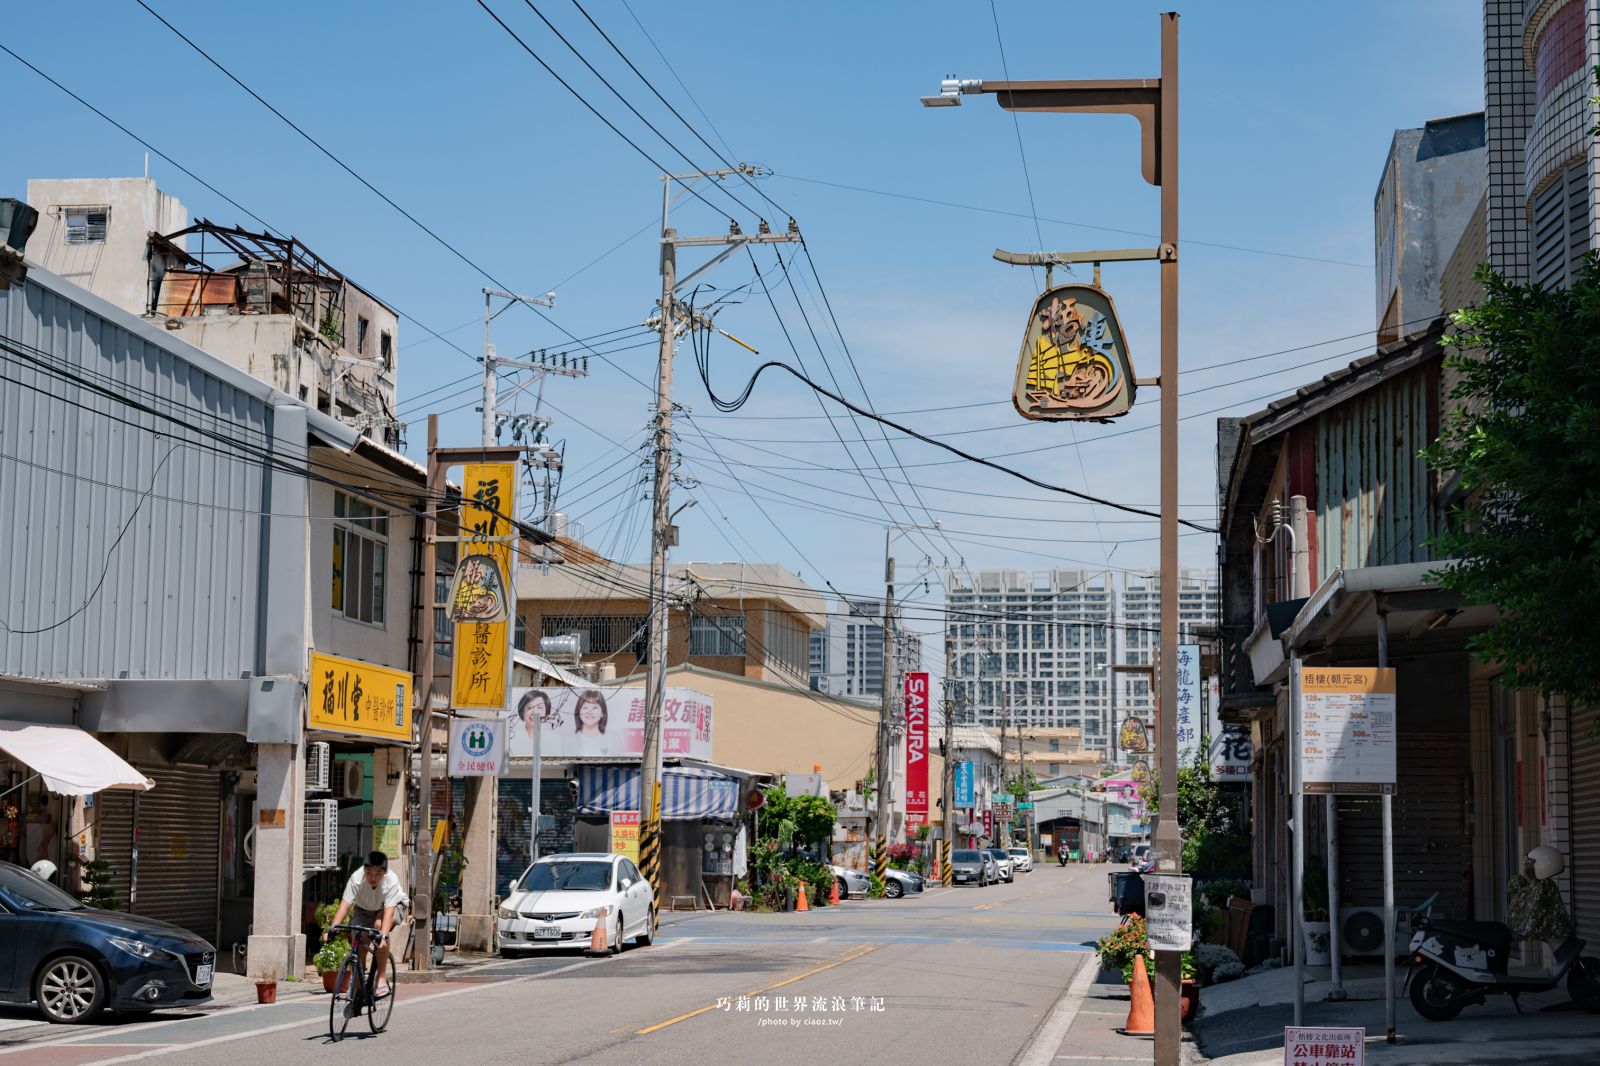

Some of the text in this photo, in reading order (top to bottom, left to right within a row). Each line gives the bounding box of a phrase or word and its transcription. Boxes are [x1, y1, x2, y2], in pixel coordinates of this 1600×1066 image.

[322, 670, 363, 721] 福川堂
[908, 678, 924, 764] SAKURA
[457, 760, 496, 772] 全民健保
[1293, 1043, 1356, 1058] 公車靠站
